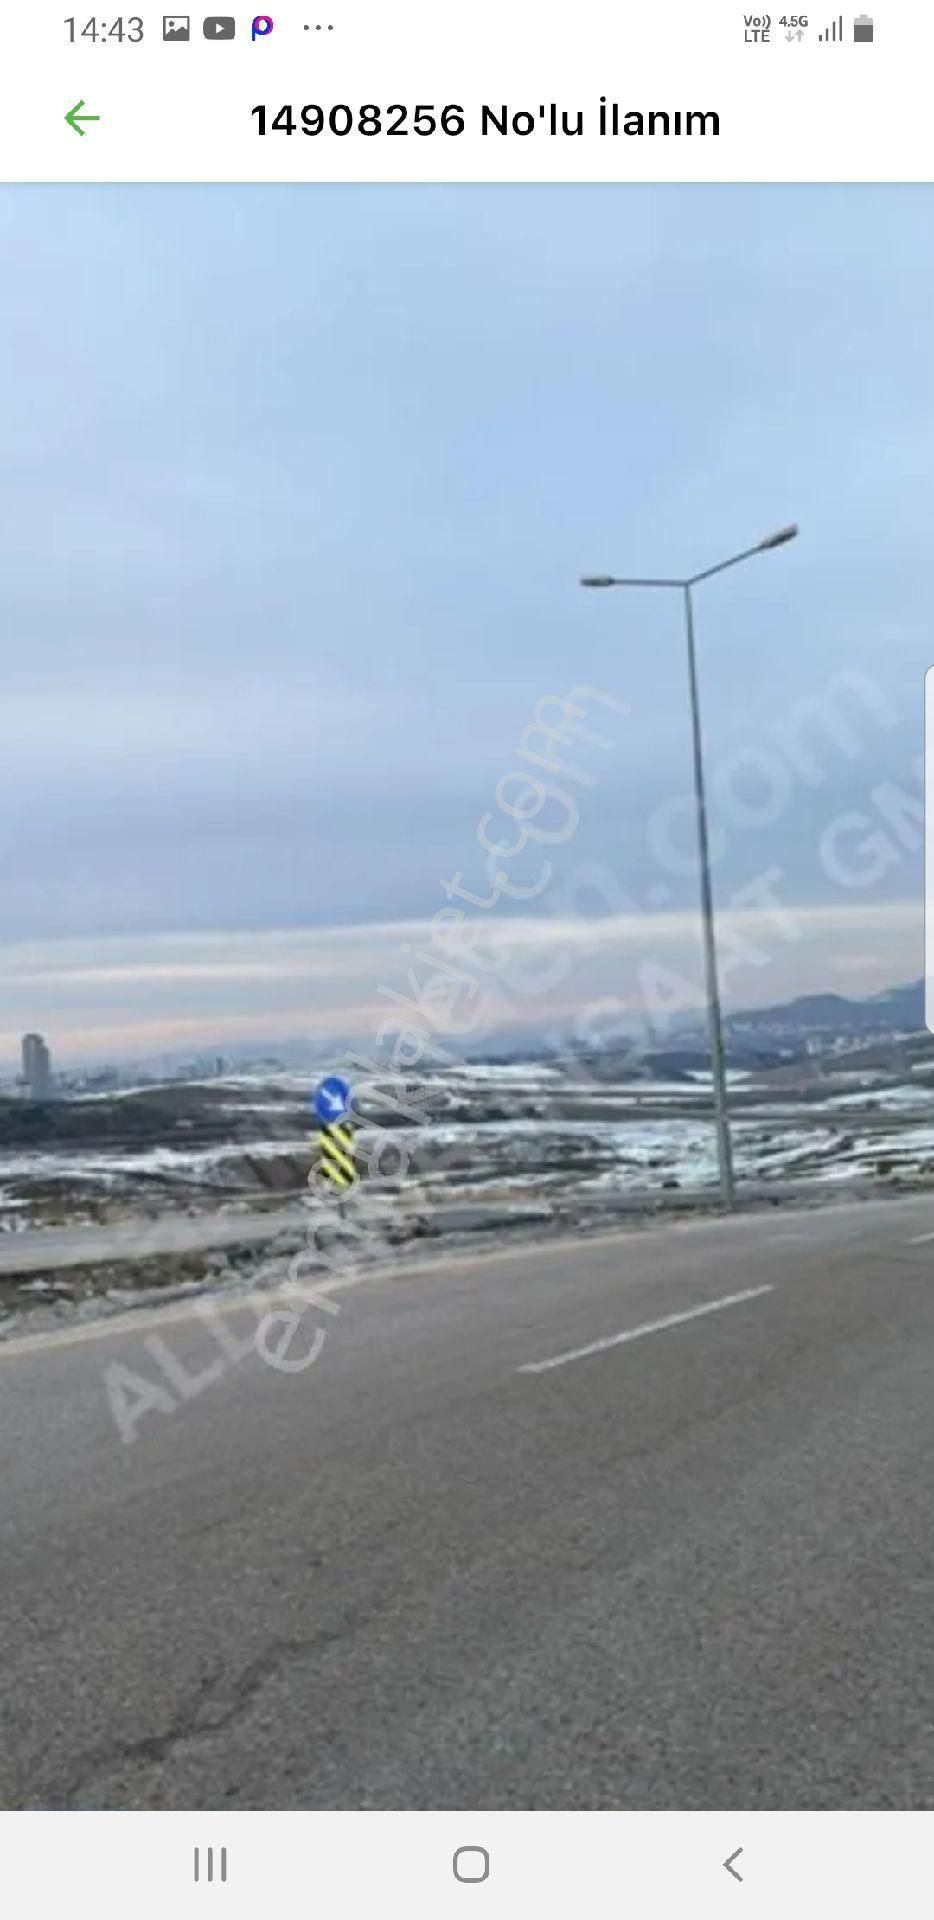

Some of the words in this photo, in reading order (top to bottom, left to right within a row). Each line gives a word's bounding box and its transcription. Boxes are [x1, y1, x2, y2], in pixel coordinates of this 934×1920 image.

[63, 16, 144, 43] 14:43
[778, 15, 808, 28] 4.5G
[744, 29, 770, 42] LTE
[250, 104, 466, 136] 14908256
[481, 103, 584, 136] No'lu
[599, 95, 721, 136] İlanım
